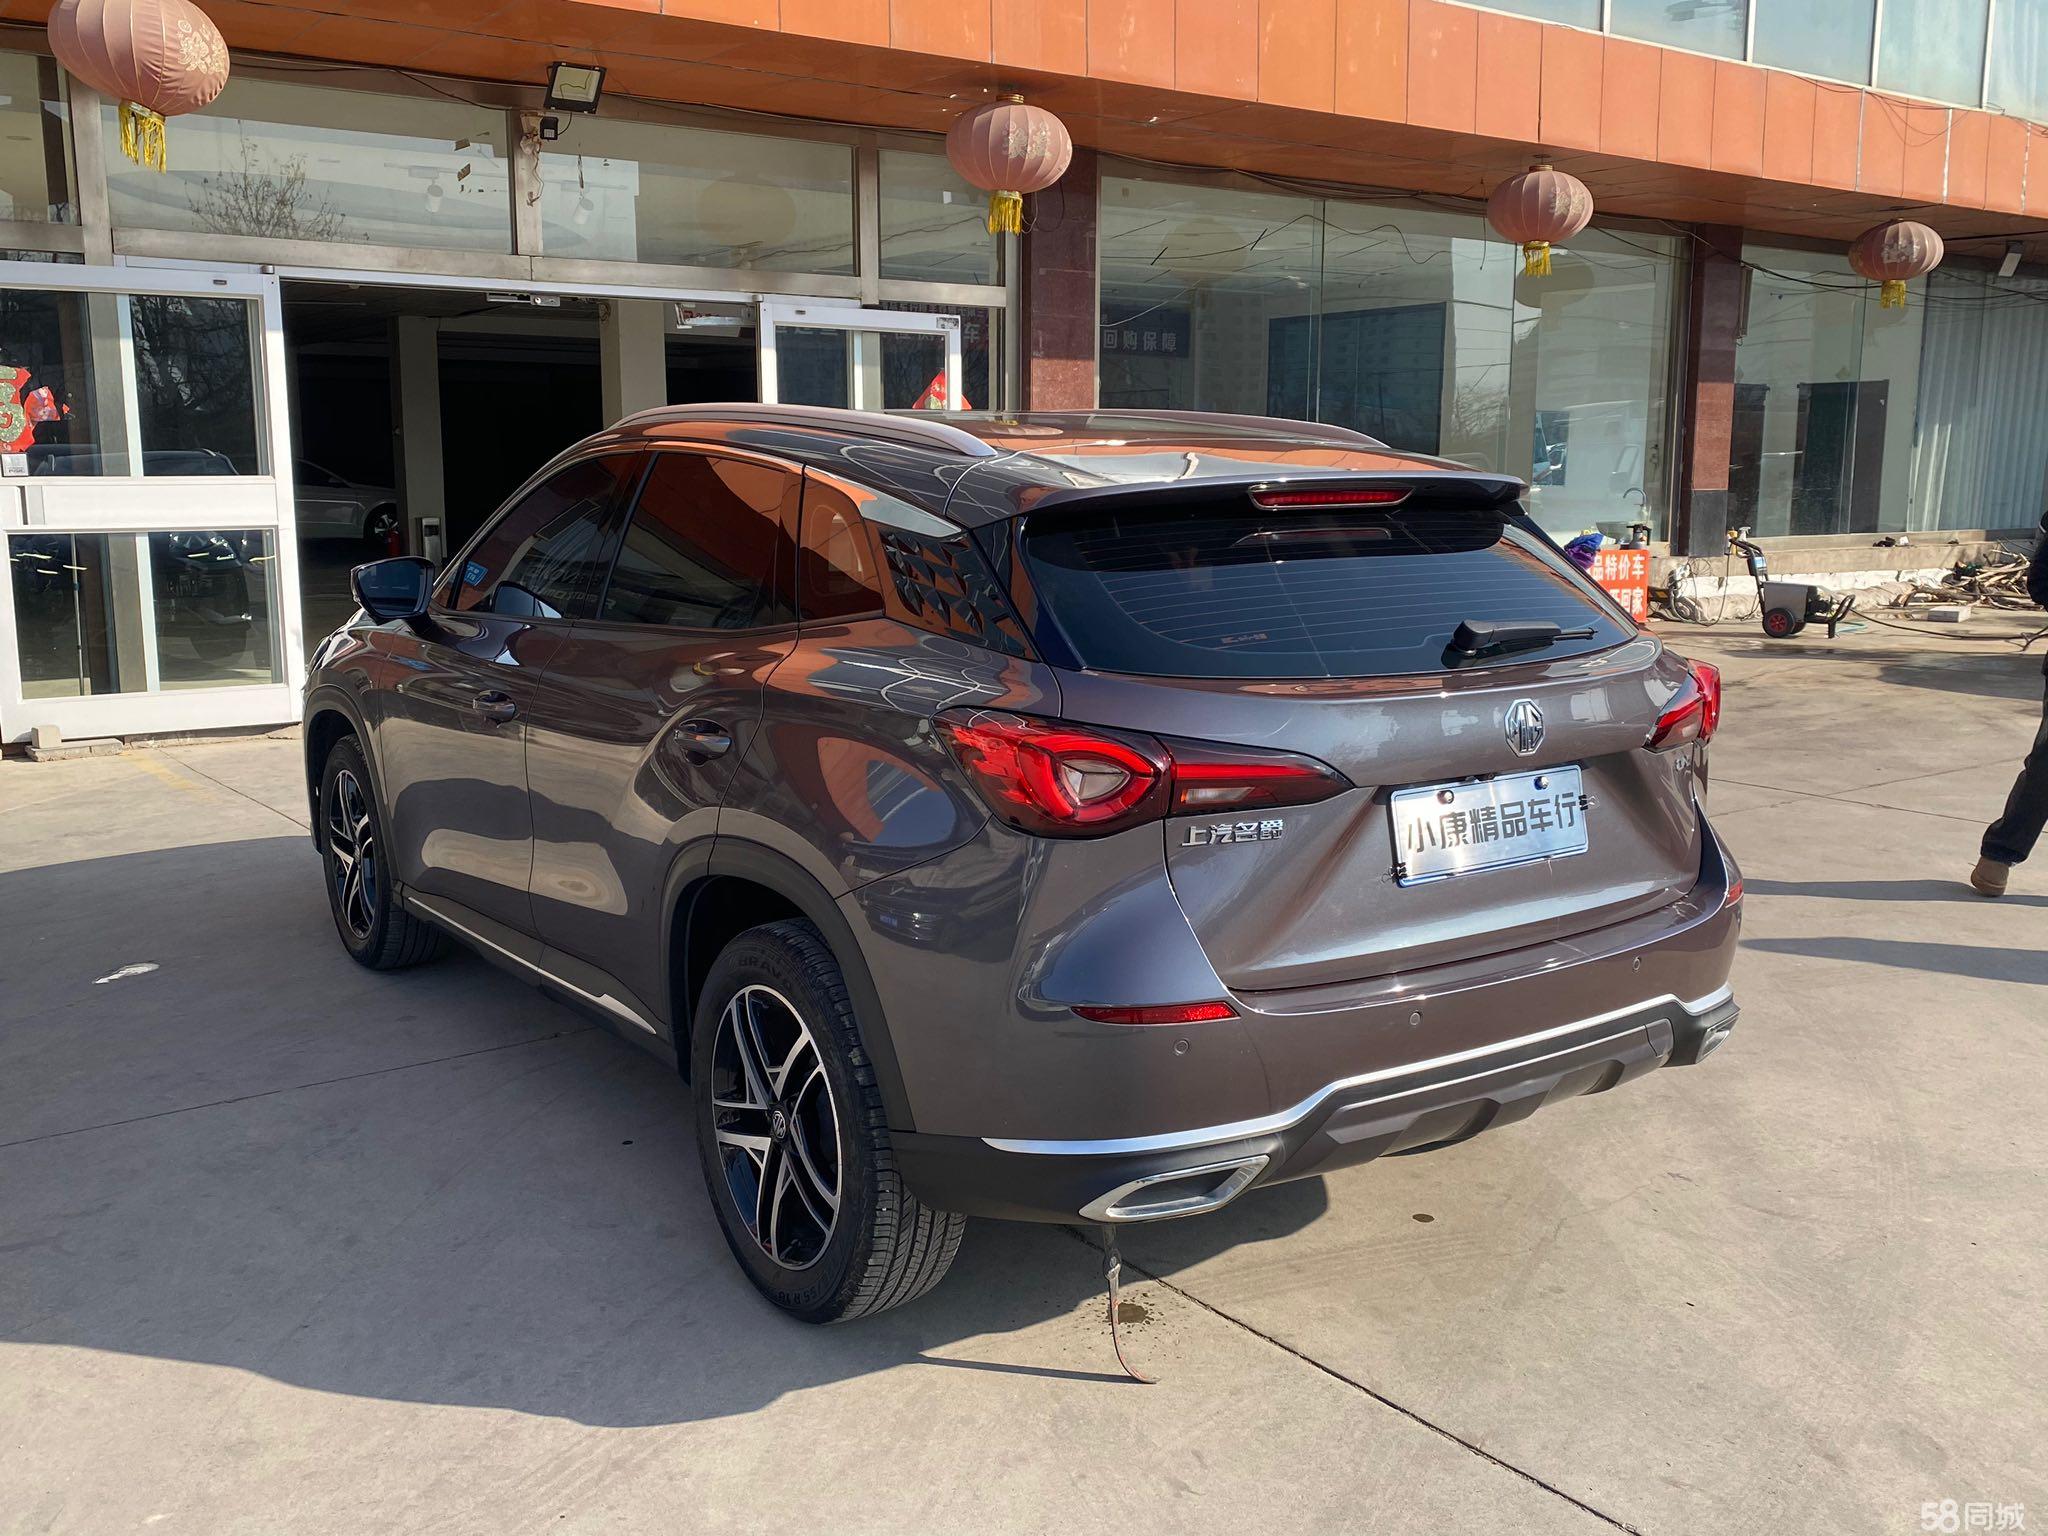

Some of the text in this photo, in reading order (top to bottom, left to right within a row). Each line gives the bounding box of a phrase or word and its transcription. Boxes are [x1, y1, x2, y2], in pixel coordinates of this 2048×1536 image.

[1103, 329, 1177, 351] 回购保障
[1588, 554, 1646, 581] 品特价车
[1505, 699, 1544, 756] MG
[1182, 819, 1284, 846] 上汽名爵
[1407, 792, 1576, 853] 小康精品车行
